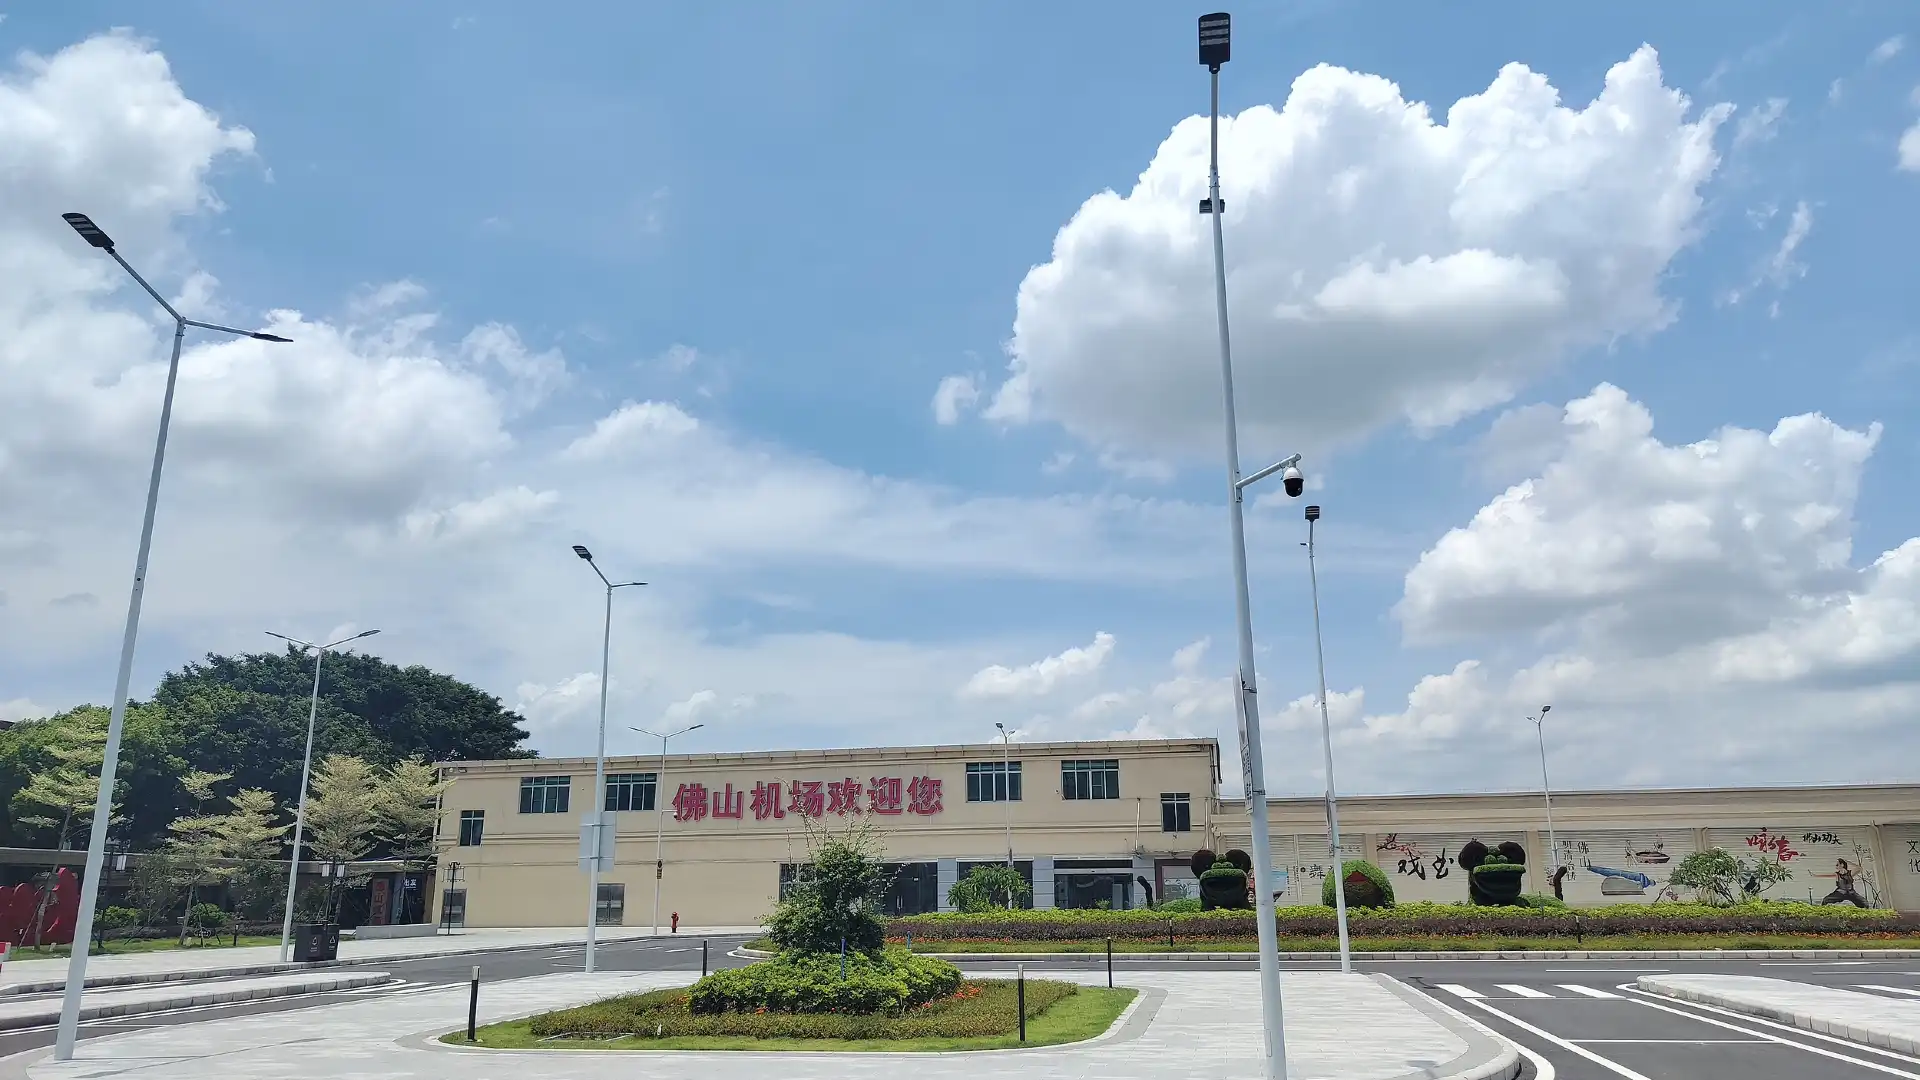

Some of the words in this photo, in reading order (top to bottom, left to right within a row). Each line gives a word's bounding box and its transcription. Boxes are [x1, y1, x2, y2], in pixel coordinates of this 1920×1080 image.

[671, 775, 944, 821] 佛山机场欢迎您
